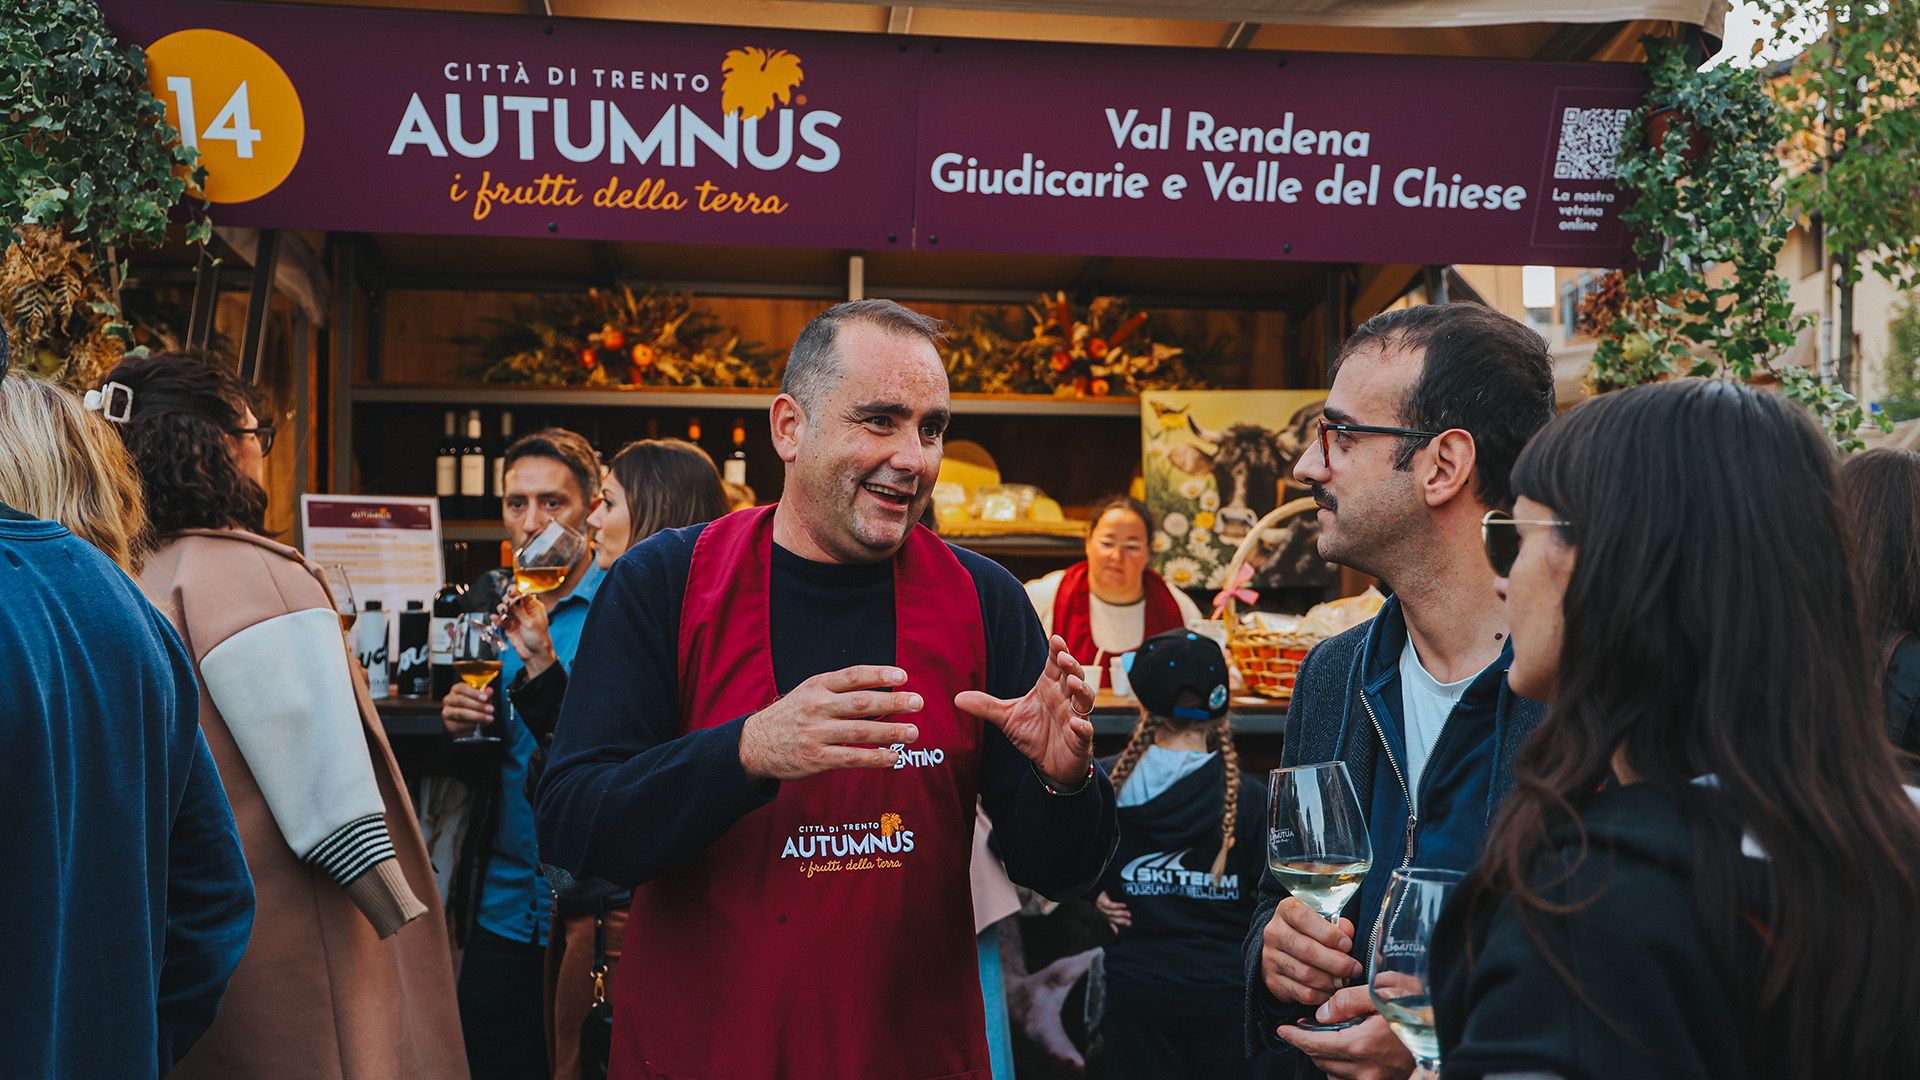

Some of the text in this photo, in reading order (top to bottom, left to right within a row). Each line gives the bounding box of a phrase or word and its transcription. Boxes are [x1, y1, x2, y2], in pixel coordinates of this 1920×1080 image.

[444, 61, 710, 93] CITTÀ DI TRENTO
[167, 76, 261, 158] 14
[387, 91, 842, 173] AUTUMNUS
[1105, 107, 1370, 157] Val Rendena
[450, 171, 790, 220] i frutti della terra
[930, 152, 1527, 210] Giudicarie e Valle del Chiese
[1552, 187, 1615, 203] La nostra
[1558, 204, 1604, 217] vetrina
[1558, 216, 1599, 231] online
[799, 825, 825, 833] CITTÀ
[843, 822, 880, 831] TRENTO
[781, 830, 915, 859] AUTUMNUS
[800, 857, 902, 878] i frutti della terra
[1137, 867, 1173, 885] SKI
